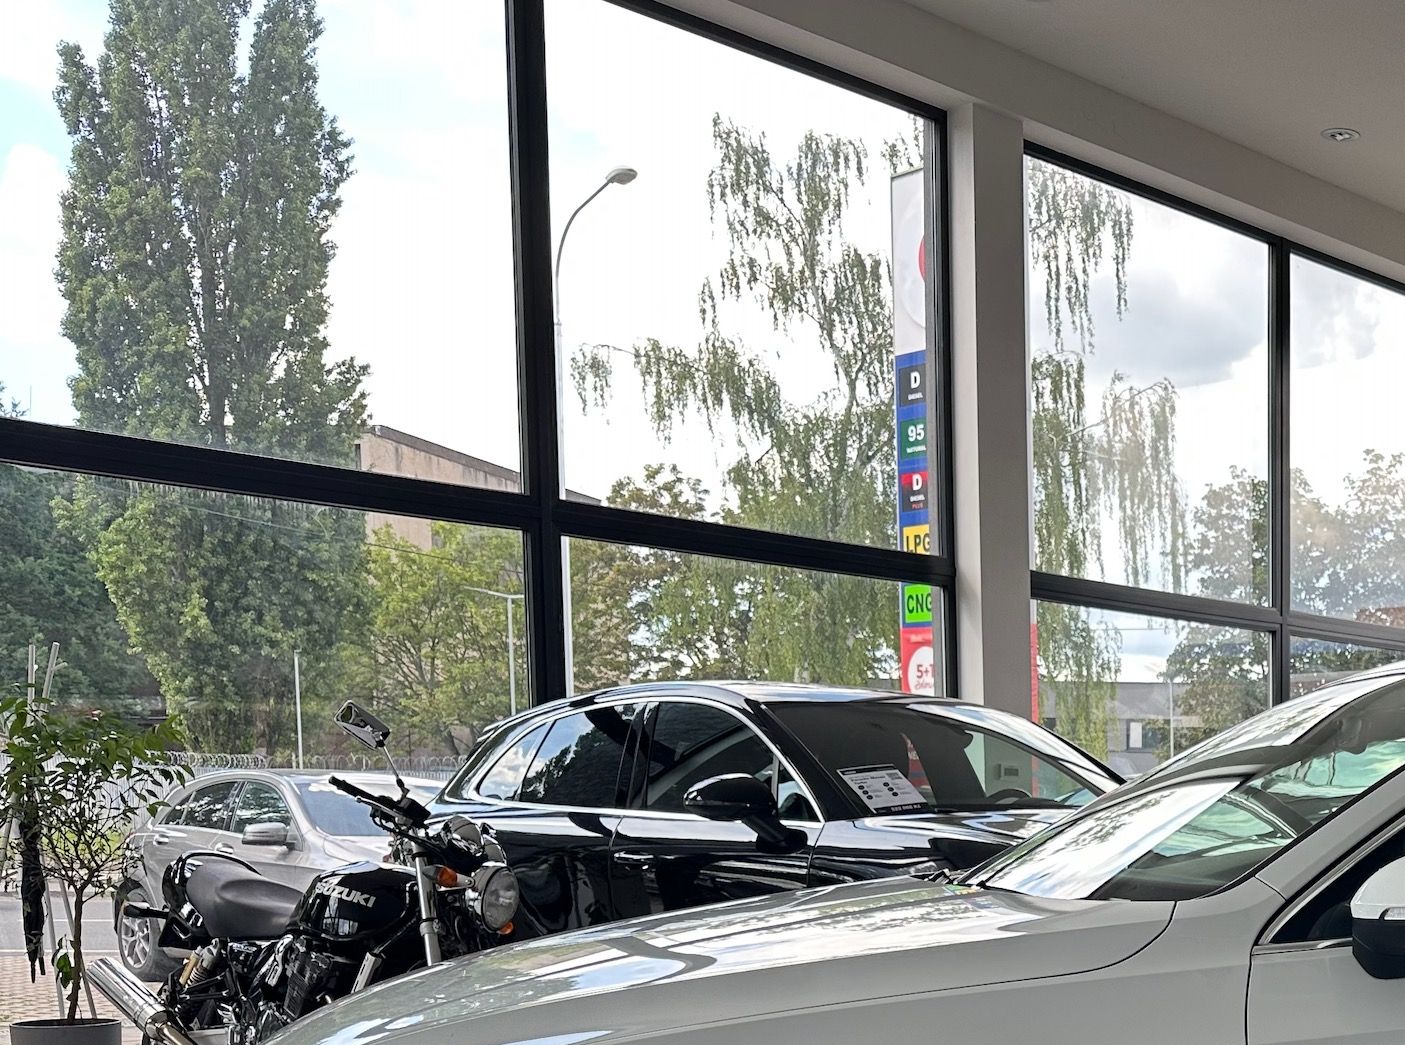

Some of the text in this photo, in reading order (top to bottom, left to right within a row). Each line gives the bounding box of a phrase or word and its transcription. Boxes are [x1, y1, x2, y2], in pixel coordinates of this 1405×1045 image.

[910, 371, 921, 389] D
[907, 424, 925, 441] 95
[912, 473, 922, 491] D
[906, 593, 932, 614] CNG
[315, 881, 376, 908] SUZUKI
